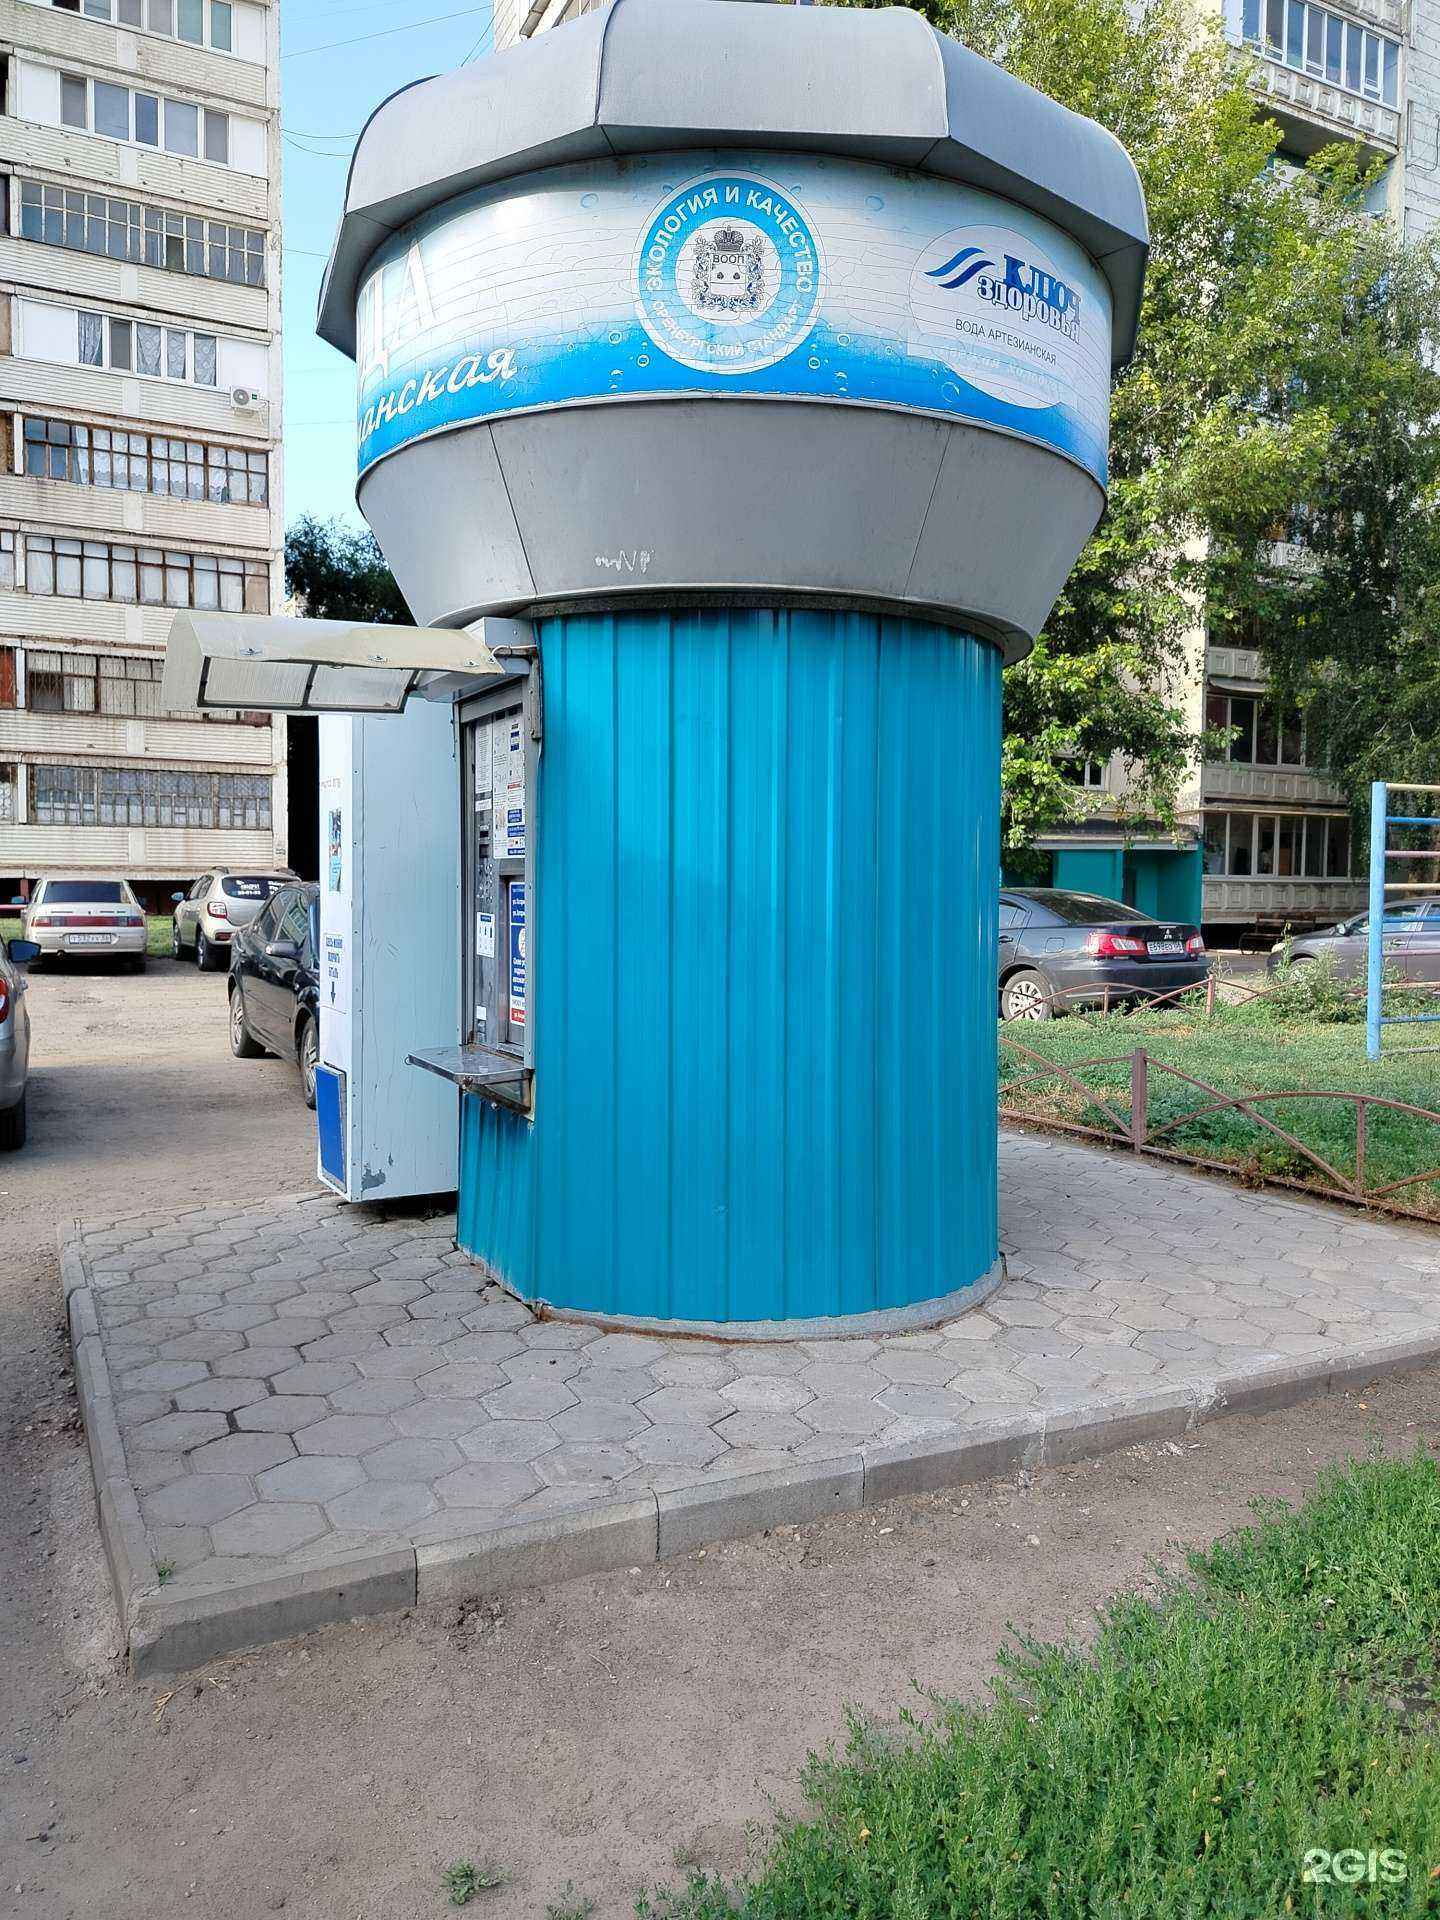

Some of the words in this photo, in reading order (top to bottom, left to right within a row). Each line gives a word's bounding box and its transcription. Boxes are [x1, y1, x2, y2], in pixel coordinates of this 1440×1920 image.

[646, 187, 718, 291] ЭКОЛОГИЯ
[724, 186, 740, 204] И
[746, 189, 813, 293] КАЧЕСТВО
[955, 318, 986, 337] ВОДА
[987, 328, 1057, 366] АРТЕЗИАНСКАЯ
[359, 347, 517, 443] анская
